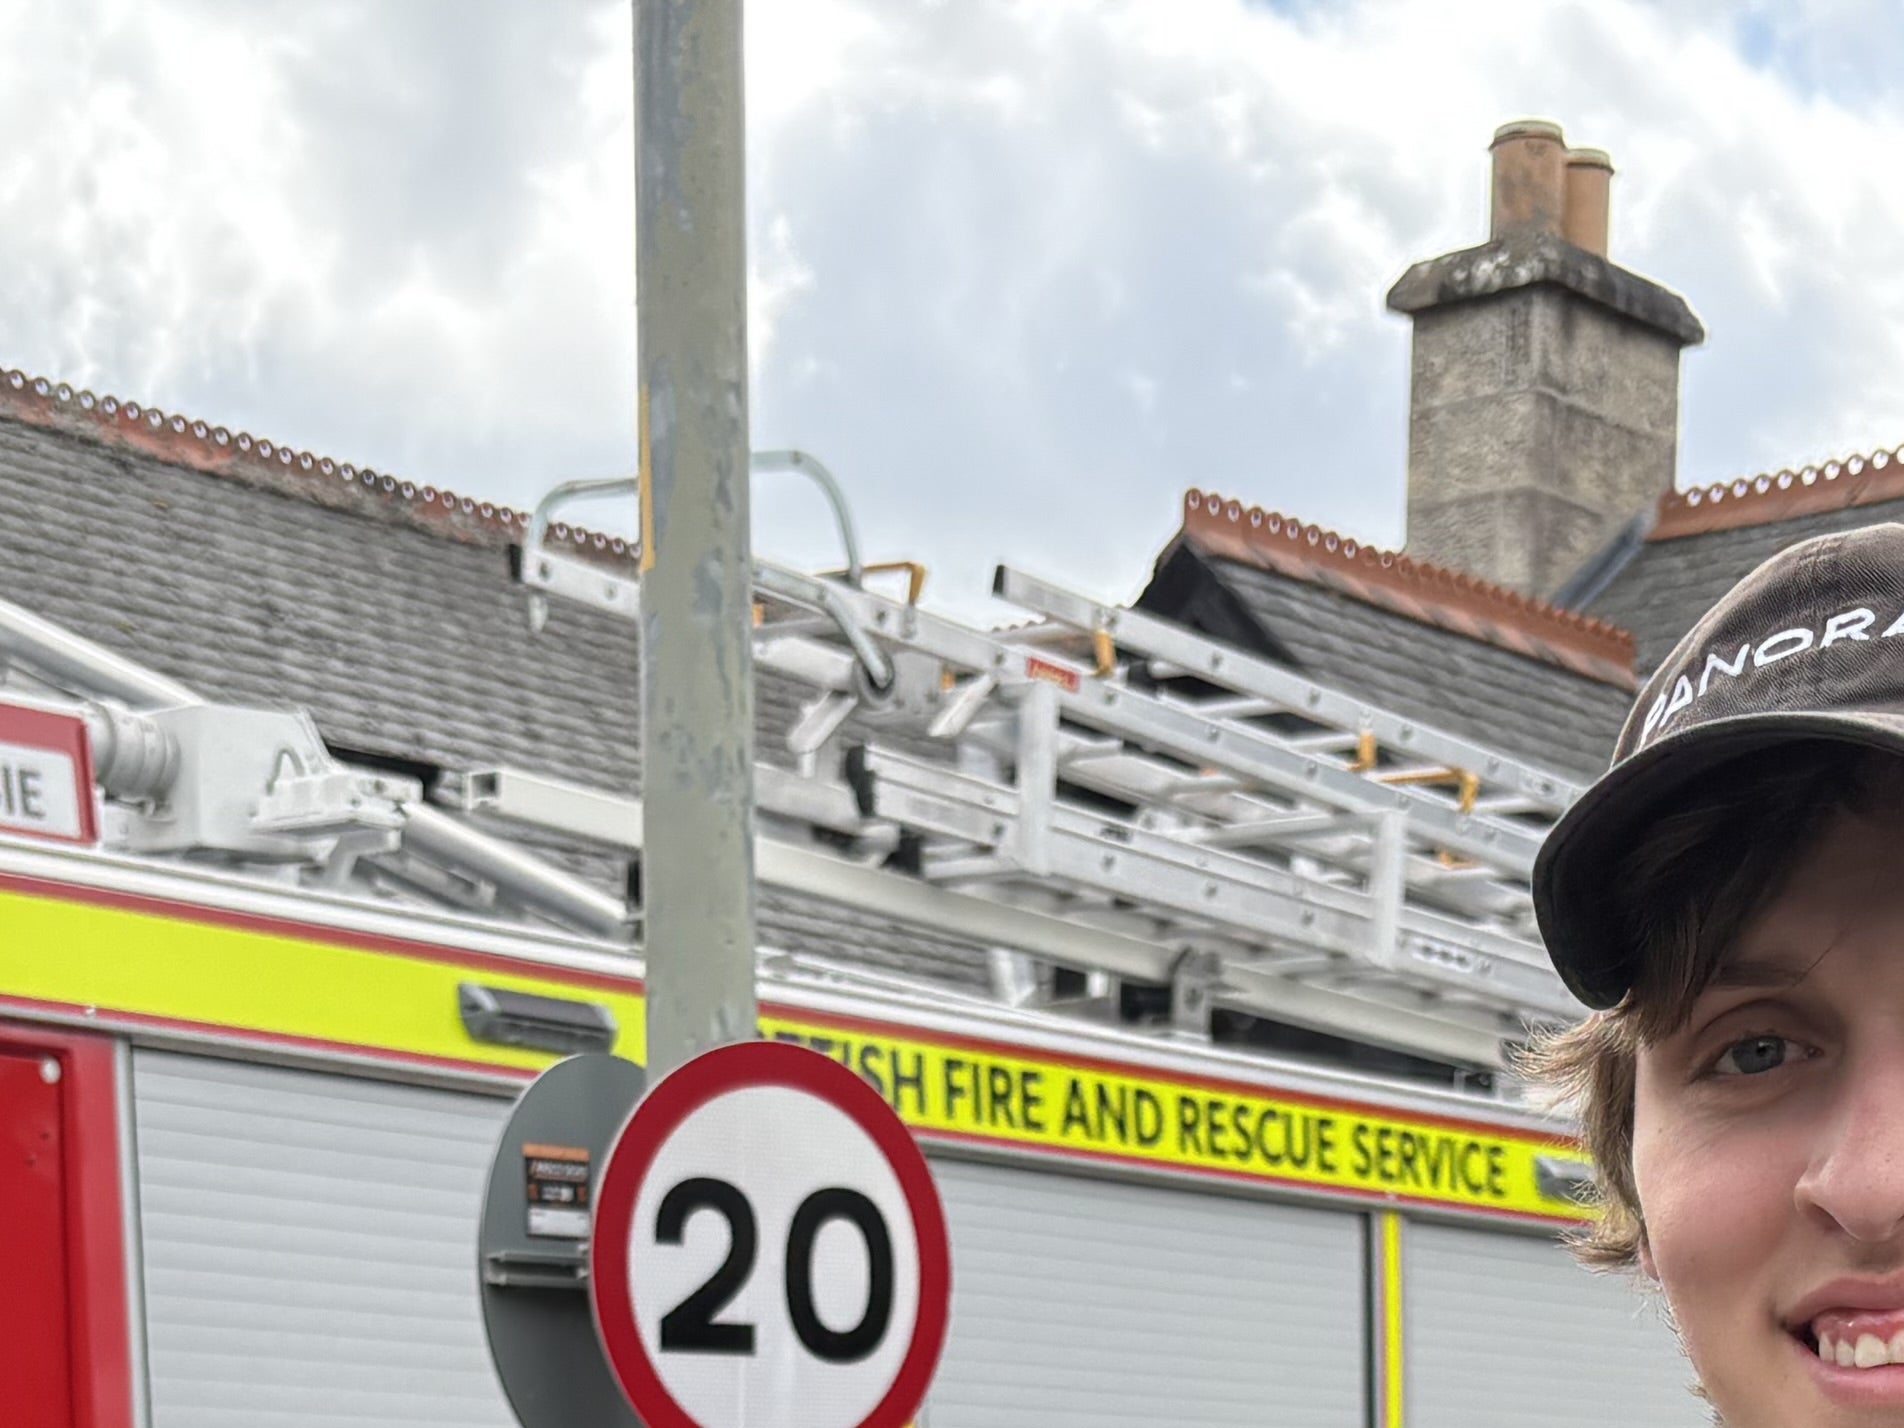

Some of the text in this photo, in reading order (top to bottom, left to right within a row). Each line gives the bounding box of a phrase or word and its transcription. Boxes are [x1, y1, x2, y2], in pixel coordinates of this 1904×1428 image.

[943, 1057, 1044, 1132] FIRE
[1061, 1077, 1164, 1147] AND
[1178, 1096, 1340, 1174] RESCUE
[1352, 1121, 1508, 1198] SERVICE
[653, 1175, 896, 1365] 20
